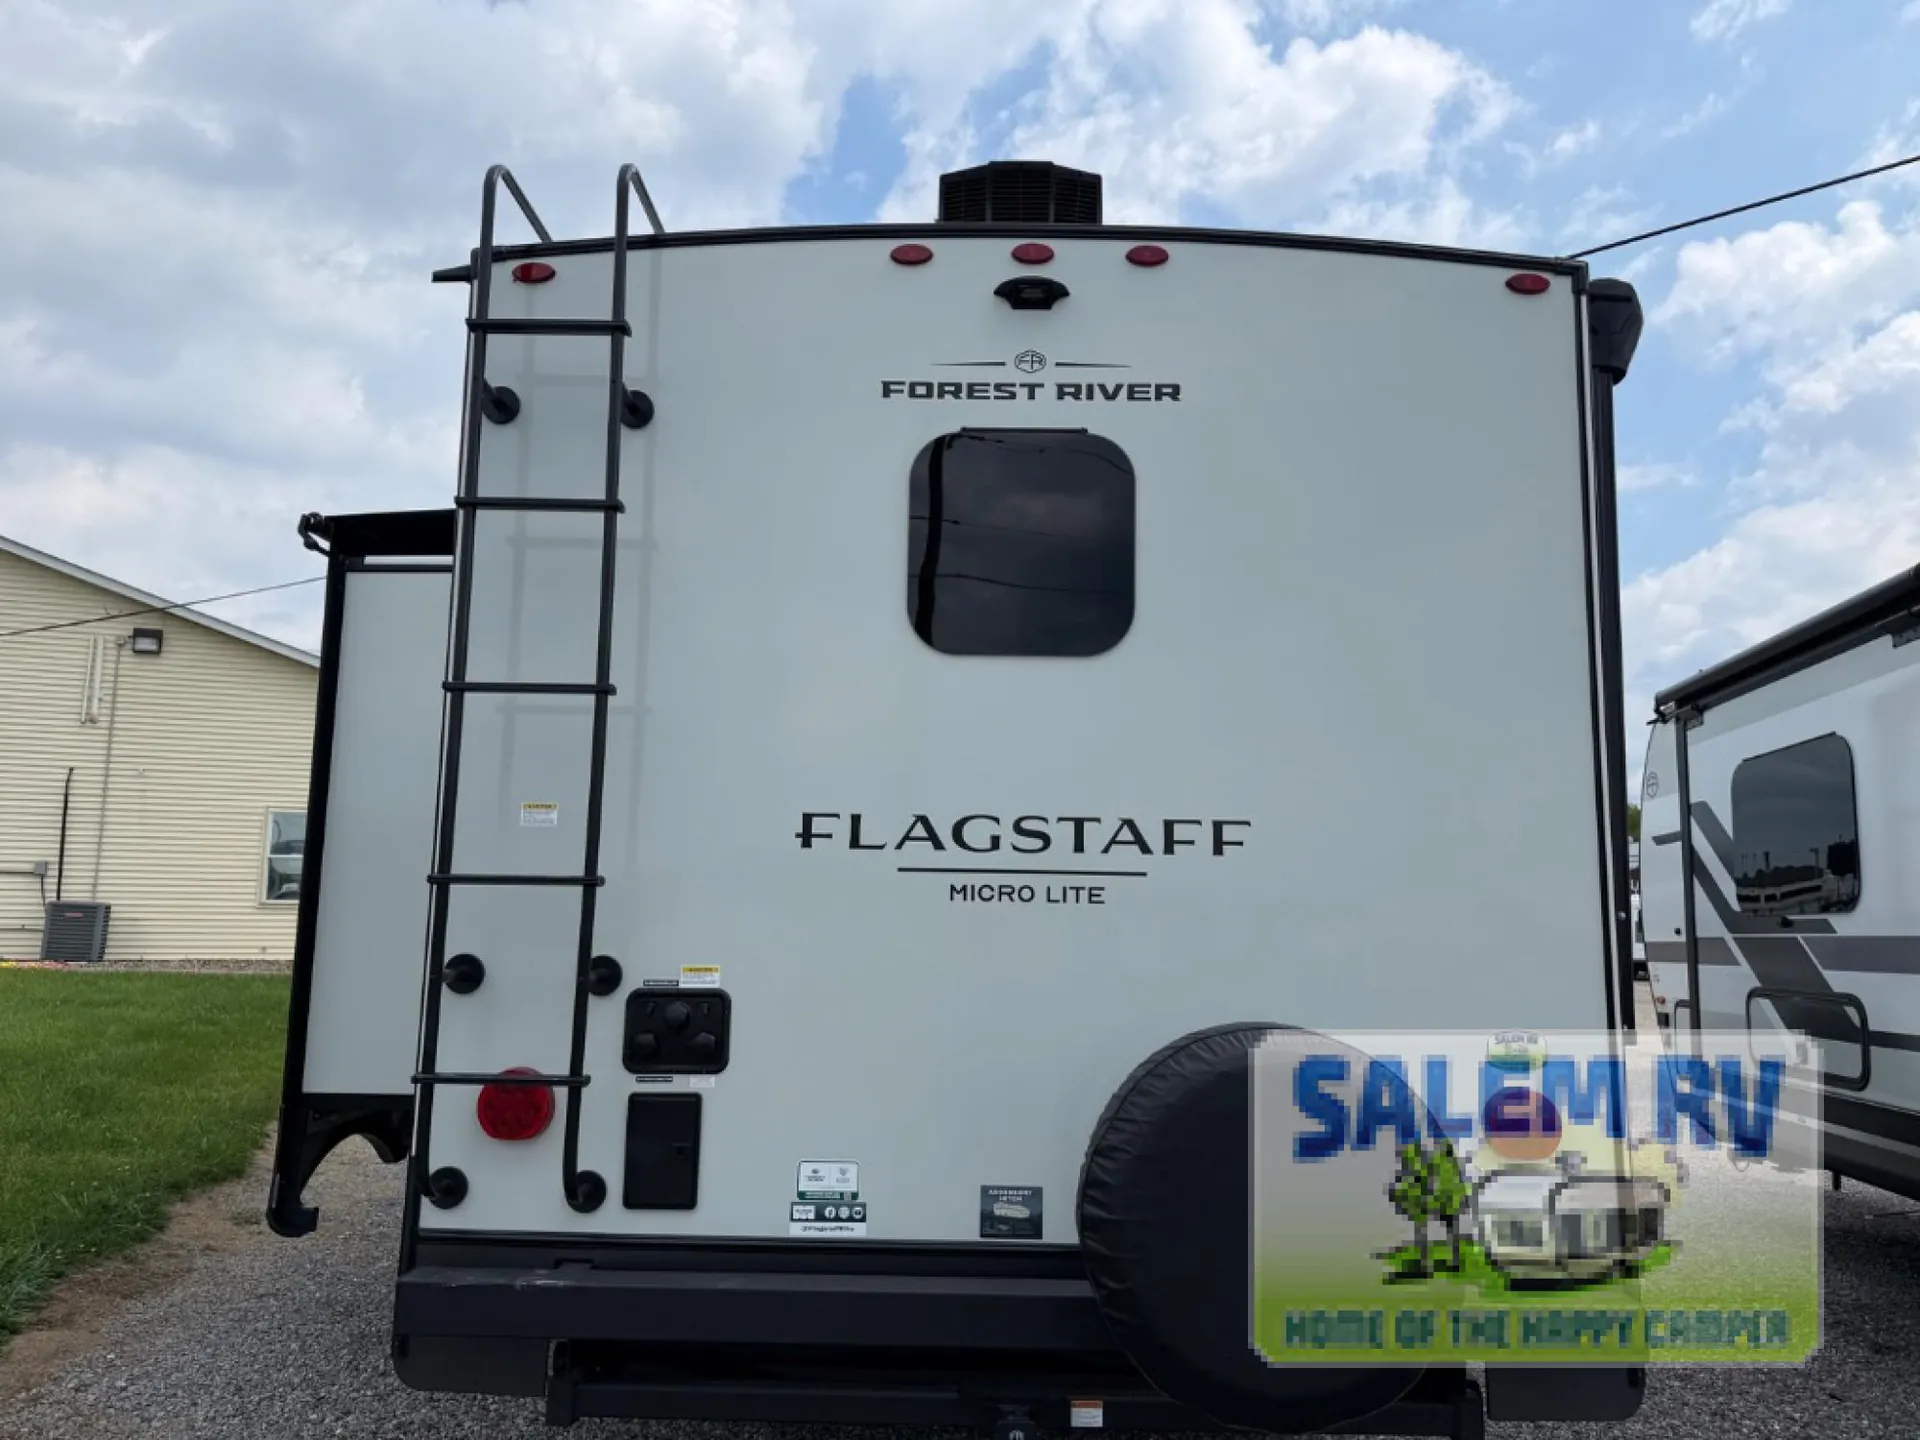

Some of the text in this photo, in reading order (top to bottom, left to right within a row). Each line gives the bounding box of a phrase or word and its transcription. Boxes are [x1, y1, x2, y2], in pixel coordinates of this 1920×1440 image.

[881, 380, 1181, 401] FOREST RIVER
[795, 812, 1251, 856] FLAGSTAFF
[950, 884, 1105, 904] MICRO LITE
